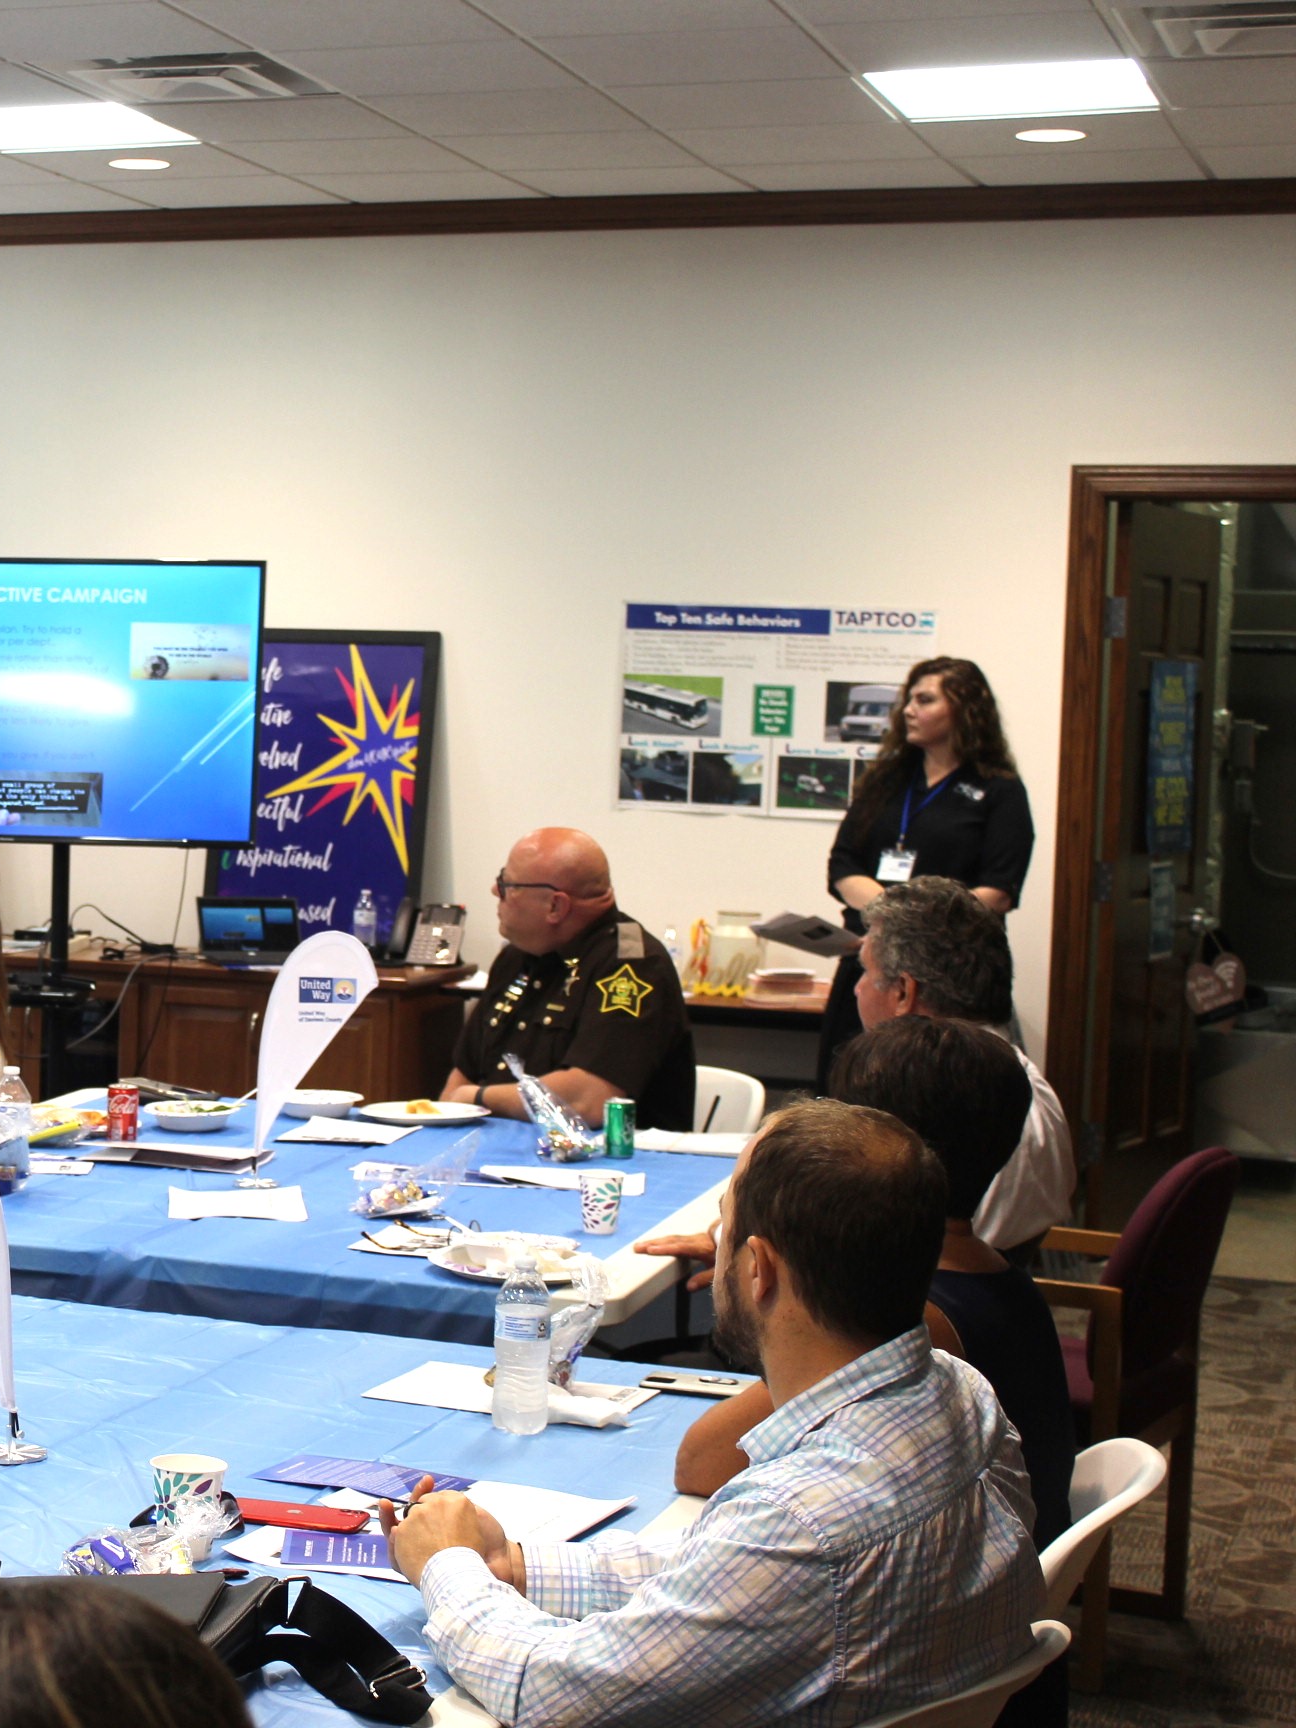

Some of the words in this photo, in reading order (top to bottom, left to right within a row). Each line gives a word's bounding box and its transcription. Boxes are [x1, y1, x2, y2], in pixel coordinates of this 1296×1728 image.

[46, 588, 147, 604] CAMPAIGN
[654, 611, 677, 626] Top
[680, 612, 702, 625] Ten
[705, 612, 734, 626] Safe
[737, 613, 801, 628] Behaviors
[835, 611, 916, 628] TAPTCO
[301, 979, 331, 990] United
[312, 990, 331, 1002] Way
